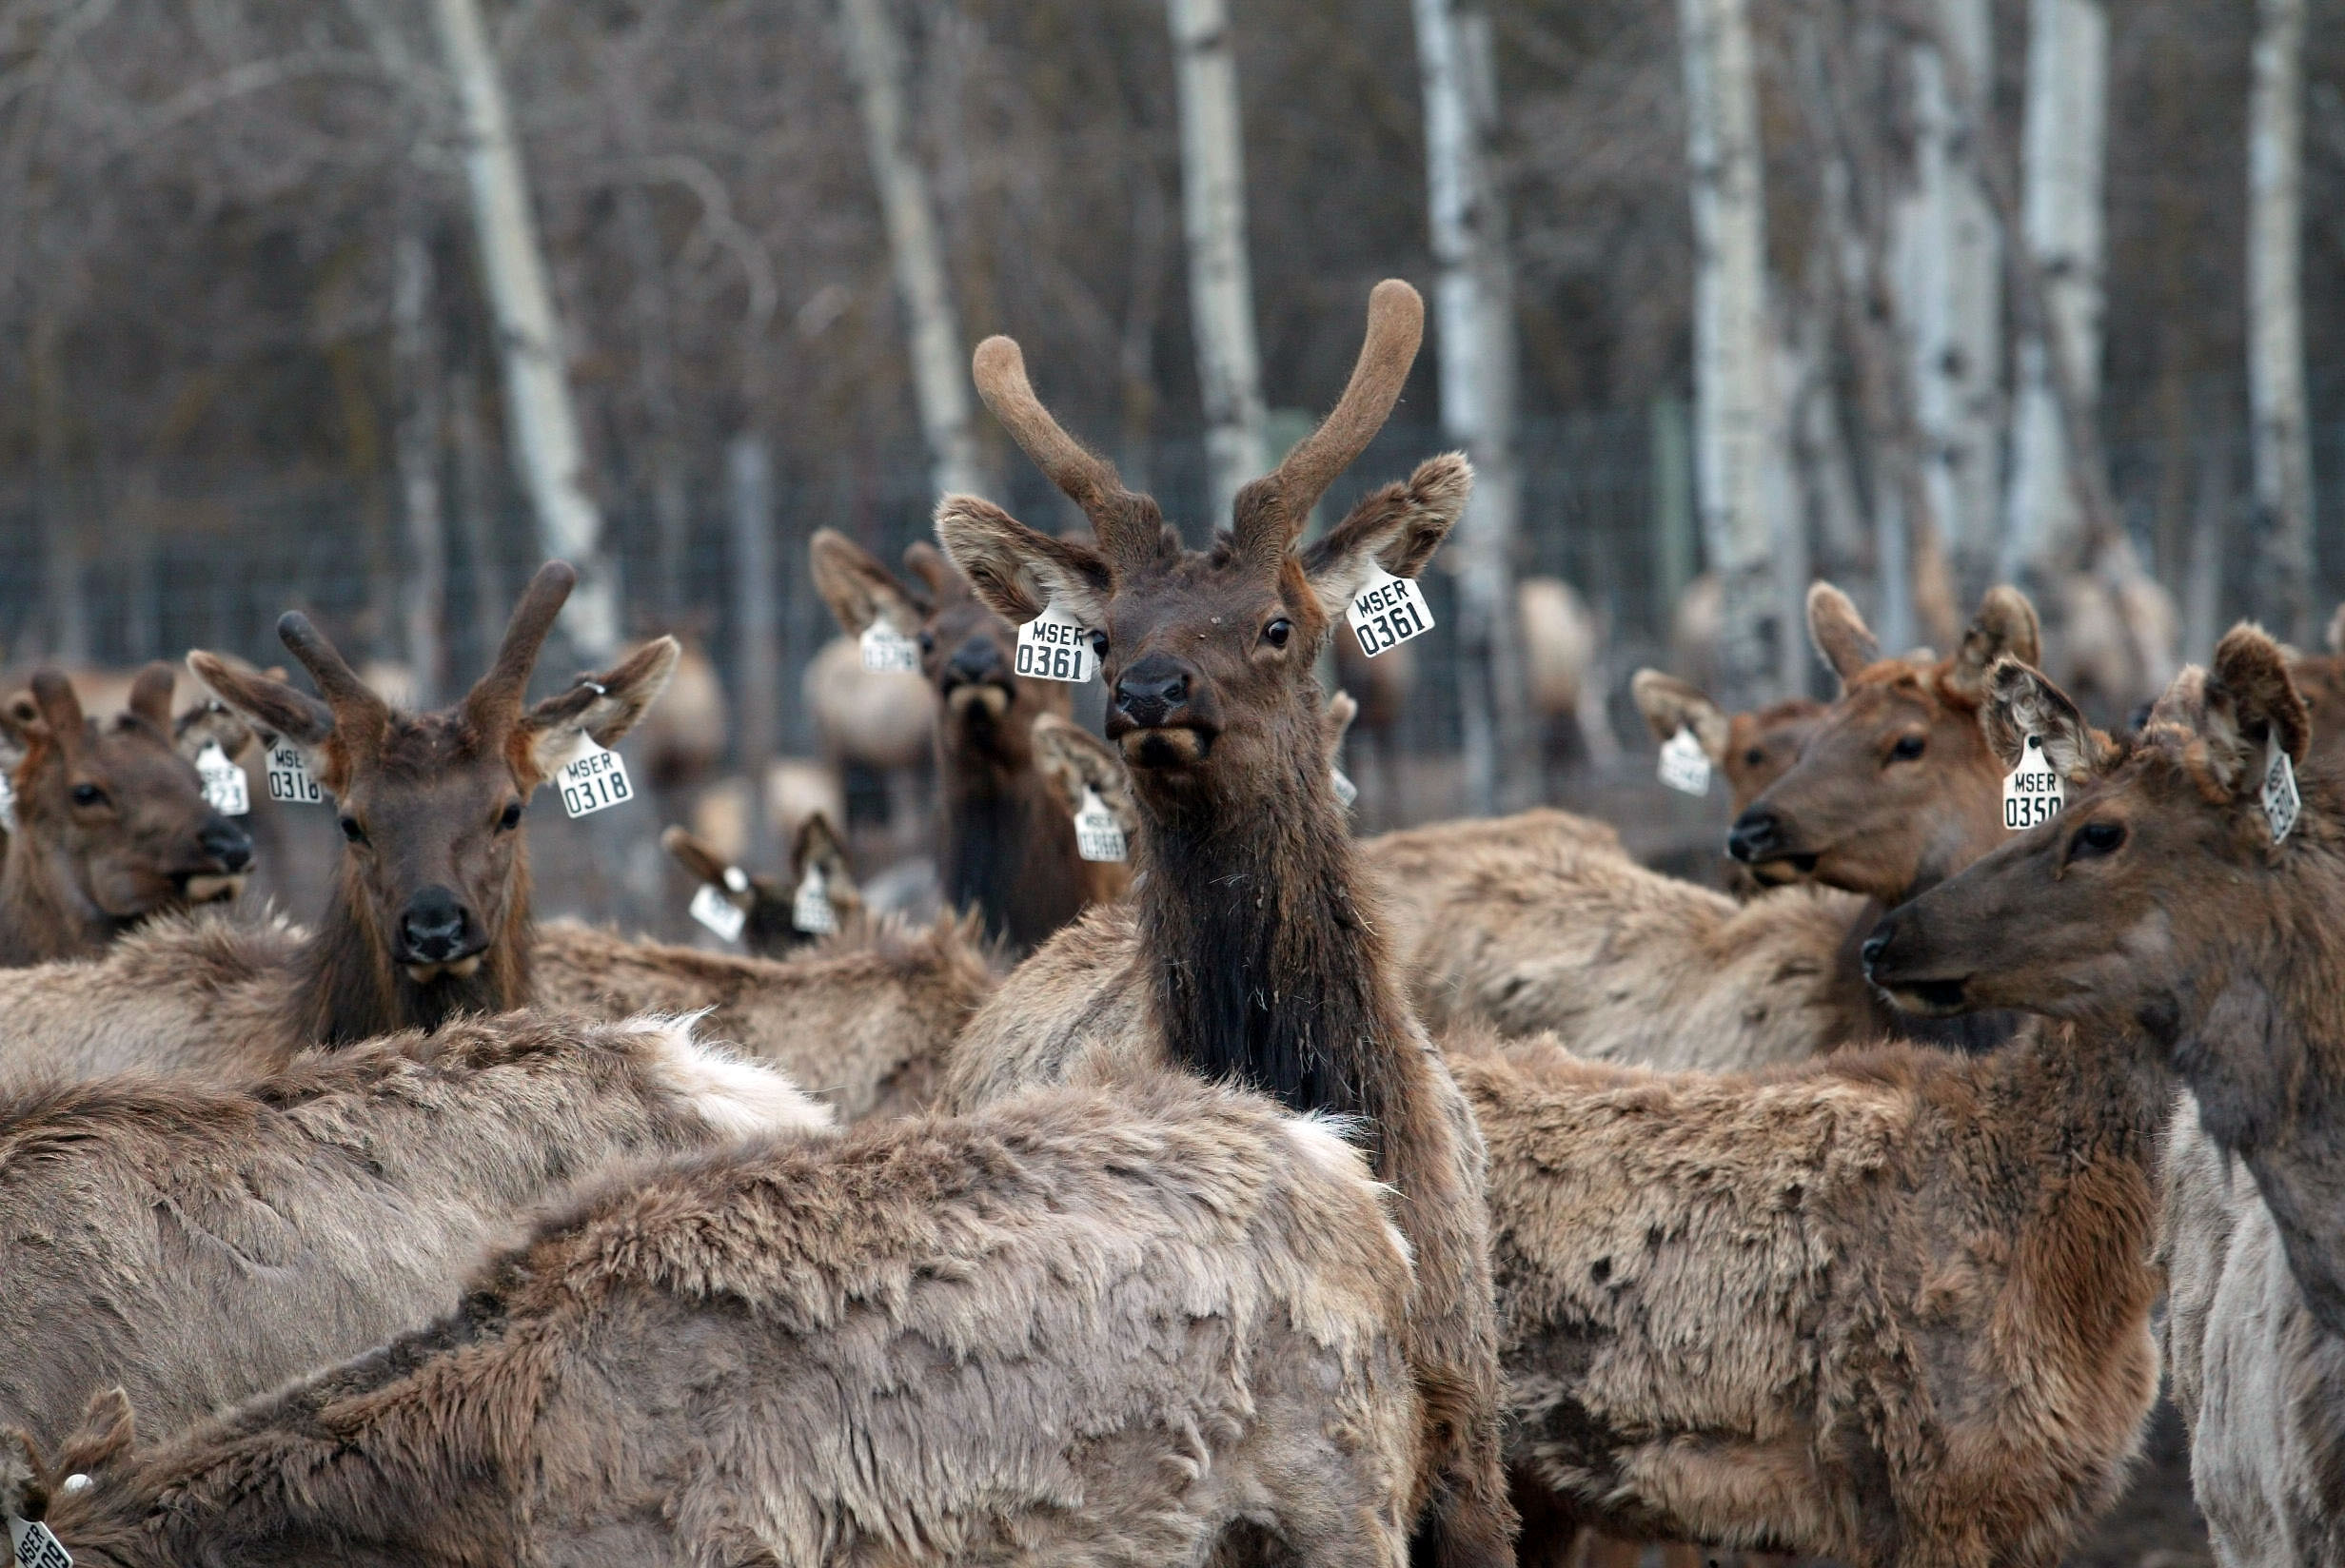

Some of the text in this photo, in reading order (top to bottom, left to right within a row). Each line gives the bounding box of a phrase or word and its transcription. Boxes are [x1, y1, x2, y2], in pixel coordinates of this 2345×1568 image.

[1355, 579, 1409, 618] MSER
[1033, 621, 1084, 646] MSER
[1357, 602, 1426, 655] 0361
[1017, 644, 1082, 679] 0361
[274, 749, 304, 769] MSE
[566, 753, 613, 781] MSER
[565, 772, 627, 813] 0318
[2015, 774, 2056, 792] MSER
[2005, 796, 2061, 827] 0350
[15, 1524, 45, 1568] MSER
